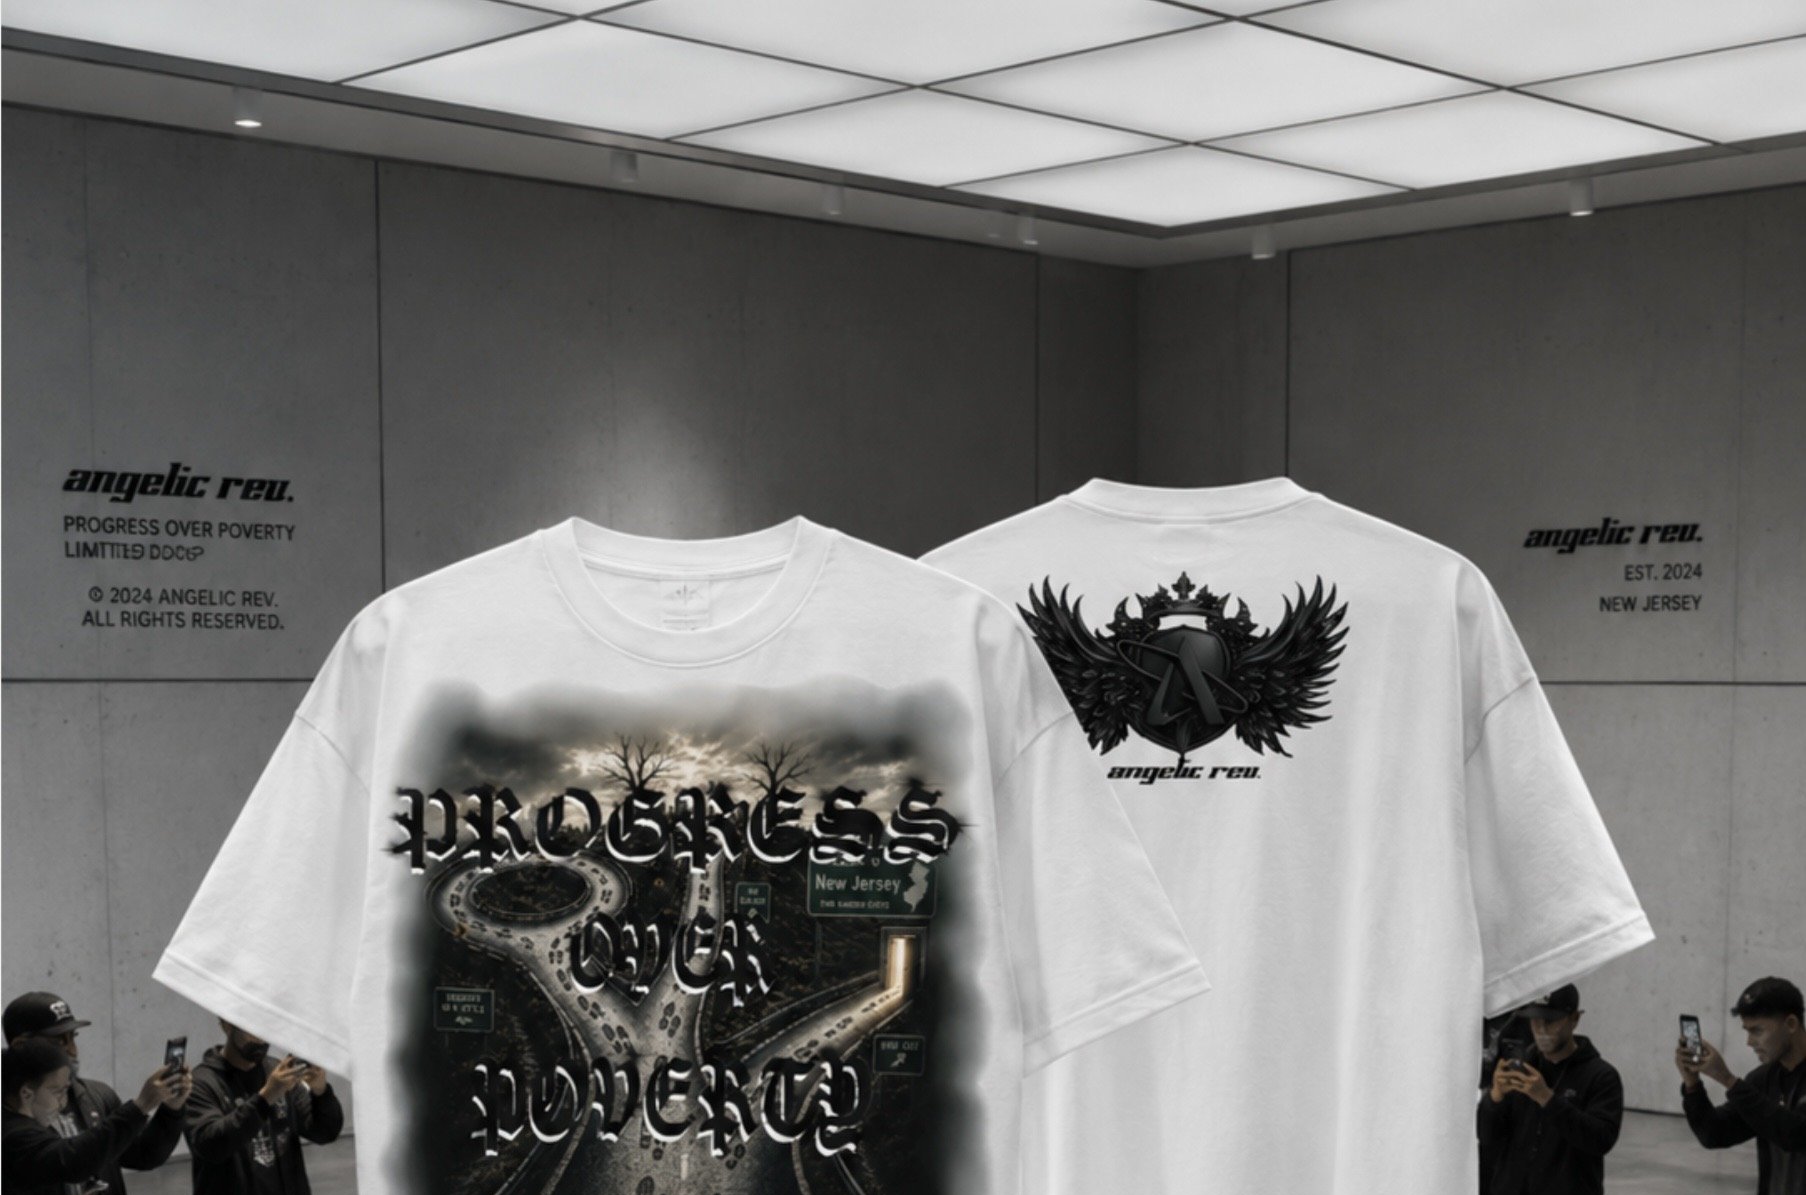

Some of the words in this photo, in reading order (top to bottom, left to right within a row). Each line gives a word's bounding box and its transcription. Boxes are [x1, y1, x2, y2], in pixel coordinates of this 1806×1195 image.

[62, 462, 211, 504] angelic
[63, 516, 160, 536] PROGRESS
[164, 519, 214, 539] OVER
[217, 522, 296, 541] POVERTY
[1523, 517, 1635, 554] angelic
[1624, 565, 1658, 581] EST.
[1663, 563, 1703, 580] 2024
[109, 587, 153, 604] 2024
[158, 588, 236, 607] ANGELIC
[242, 591, 279, 608] REV.
[1599, 596, 1637, 612] NEW
[1642, 595, 1702, 613] JERSEY
[81, 611, 115, 627] ALL
[120, 611, 186, 628] RIGHTS
[191, 612, 285, 630] RESERVED.
[1107, 758, 1204, 784] angelic
[382, 776, 966, 876] PROGRESS
[815, 873, 847, 891] New
[851, 875, 901, 895] Jersey
[570, 912, 777, 1007] OVER
[470, 1049, 872, 1157] POVERTY
